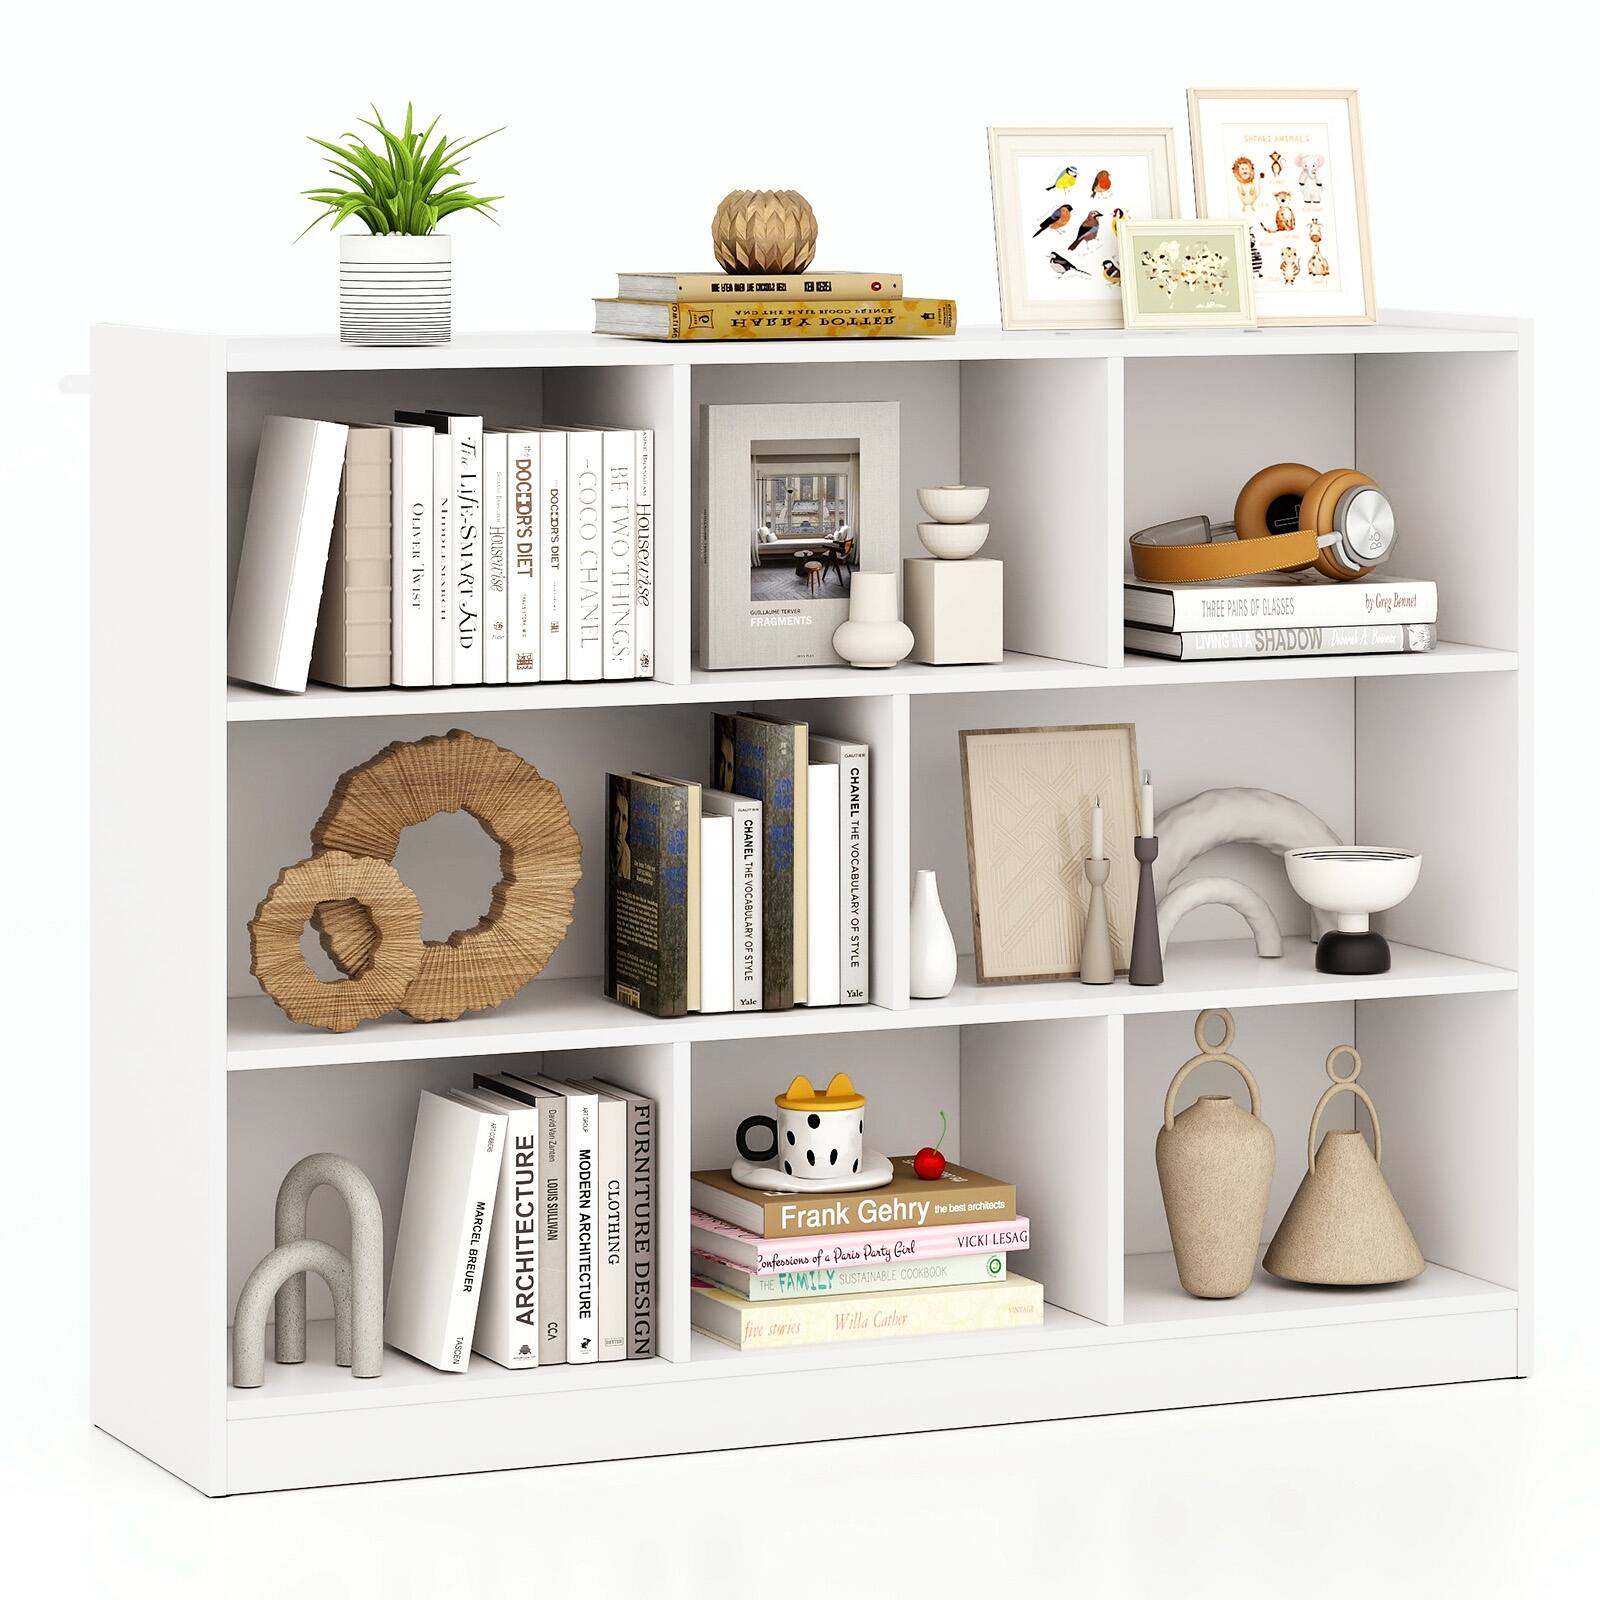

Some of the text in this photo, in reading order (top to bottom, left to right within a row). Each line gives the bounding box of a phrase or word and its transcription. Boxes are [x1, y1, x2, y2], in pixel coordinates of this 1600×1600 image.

[611, 499, 630, 557] TWO
[411, 503, 425, 610] OLIVER TWIST
[489, 526, 505, 593] Housewise
[516, 543, 533, 577] DIET
[551, 546, 559, 570] DIET
[636, 504, 652, 607] Housewise
[580, 550, 599, 649] CHANEL
[1202, 597, 1295, 618] THREE PAIRS OF GLASSES
[1365, 594, 1374, 613] by
[1375, 594, 1392, 612] Greg
[751, 616, 812, 627] FRAGMENTS
[1195, 628, 1323, 652] LIVING IN A SHADOW
[850, 767, 860, 967] CHANEL THE VOCABULARY OF STYLE
[744, 820, 754, 981] CHANEL THE VOCABULARY OF STYLE
[740, 998, 757, 1006] Yale
[846, 990, 864, 998] Yale
[548, 1109, 557, 1162] David Van Zanten
[547, 1178, 558, 1241] LOUIS SULLIVAN
[607, 1180, 620, 1265] CLOTHING
[781, 1198, 1006, 1230] Frank Gehry the best architects
[515, 1135, 534, 1326] ARCHITECTURE
[579, 1149, 591, 1319] MODERN ARCHITECTURE
[634, 1104, 650, 1356] FURNITURE DESIGN
[957, 1231, 1028, 1249] VICKI LESAG
[463, 1202, 486, 1293] MARCEL BREUER
[812, 1249, 823, 1267] of
[825, 1254, 830, 1262] a
[833, 1247, 860, 1263] Paris
[863, 1244, 891, 1262] Party
[894, 1239, 915, 1257] Girl
[759, 1265, 948, 1294] THE FAMILY SUSTAINABLE COOKBOOK
[744, 1320, 801, 1343] five stories
[834, 1310, 908, 1330] Willa Cather
[452, 1336, 464, 1365] TASCEN
